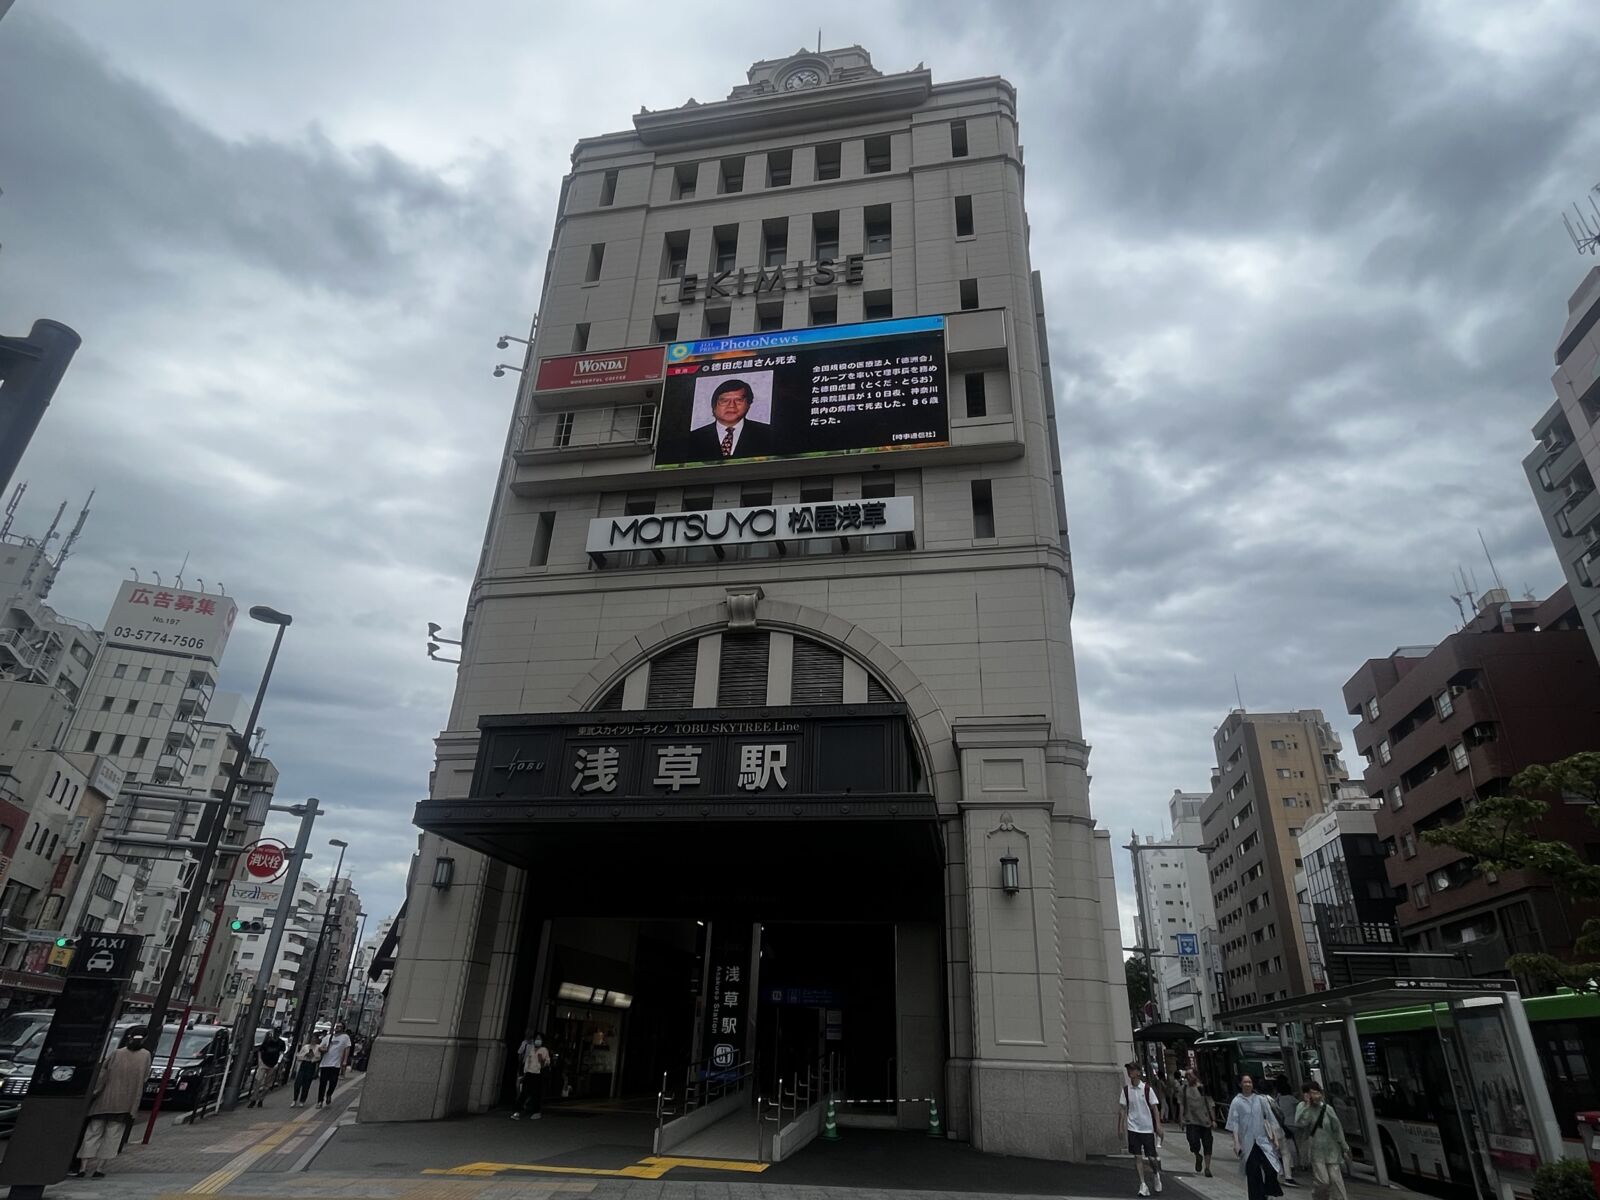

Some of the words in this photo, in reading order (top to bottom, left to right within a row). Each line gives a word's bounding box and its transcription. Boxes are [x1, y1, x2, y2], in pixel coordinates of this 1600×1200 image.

[679, 254, 864, 304] EKIMISE
[720, 335, 799, 351] PhotoNews
[578, 360, 623, 374] WONDA
[788, 501, 887, 534] 松屋浅草
[128, 588, 217, 616] 広告募集
[114, 626, 205, 649] 03-5774-7506
[675, 722, 709, 734] TOBU
[711, 721, 772, 733] SKYTREE
[774, 720, 800, 733] Line
[570, 744, 788, 793] 浅草駅
[248, 852, 282, 869] 消火栓
[90, 936, 127, 950] TAXI
[721, 966, 740, 1034] 浅草駅
